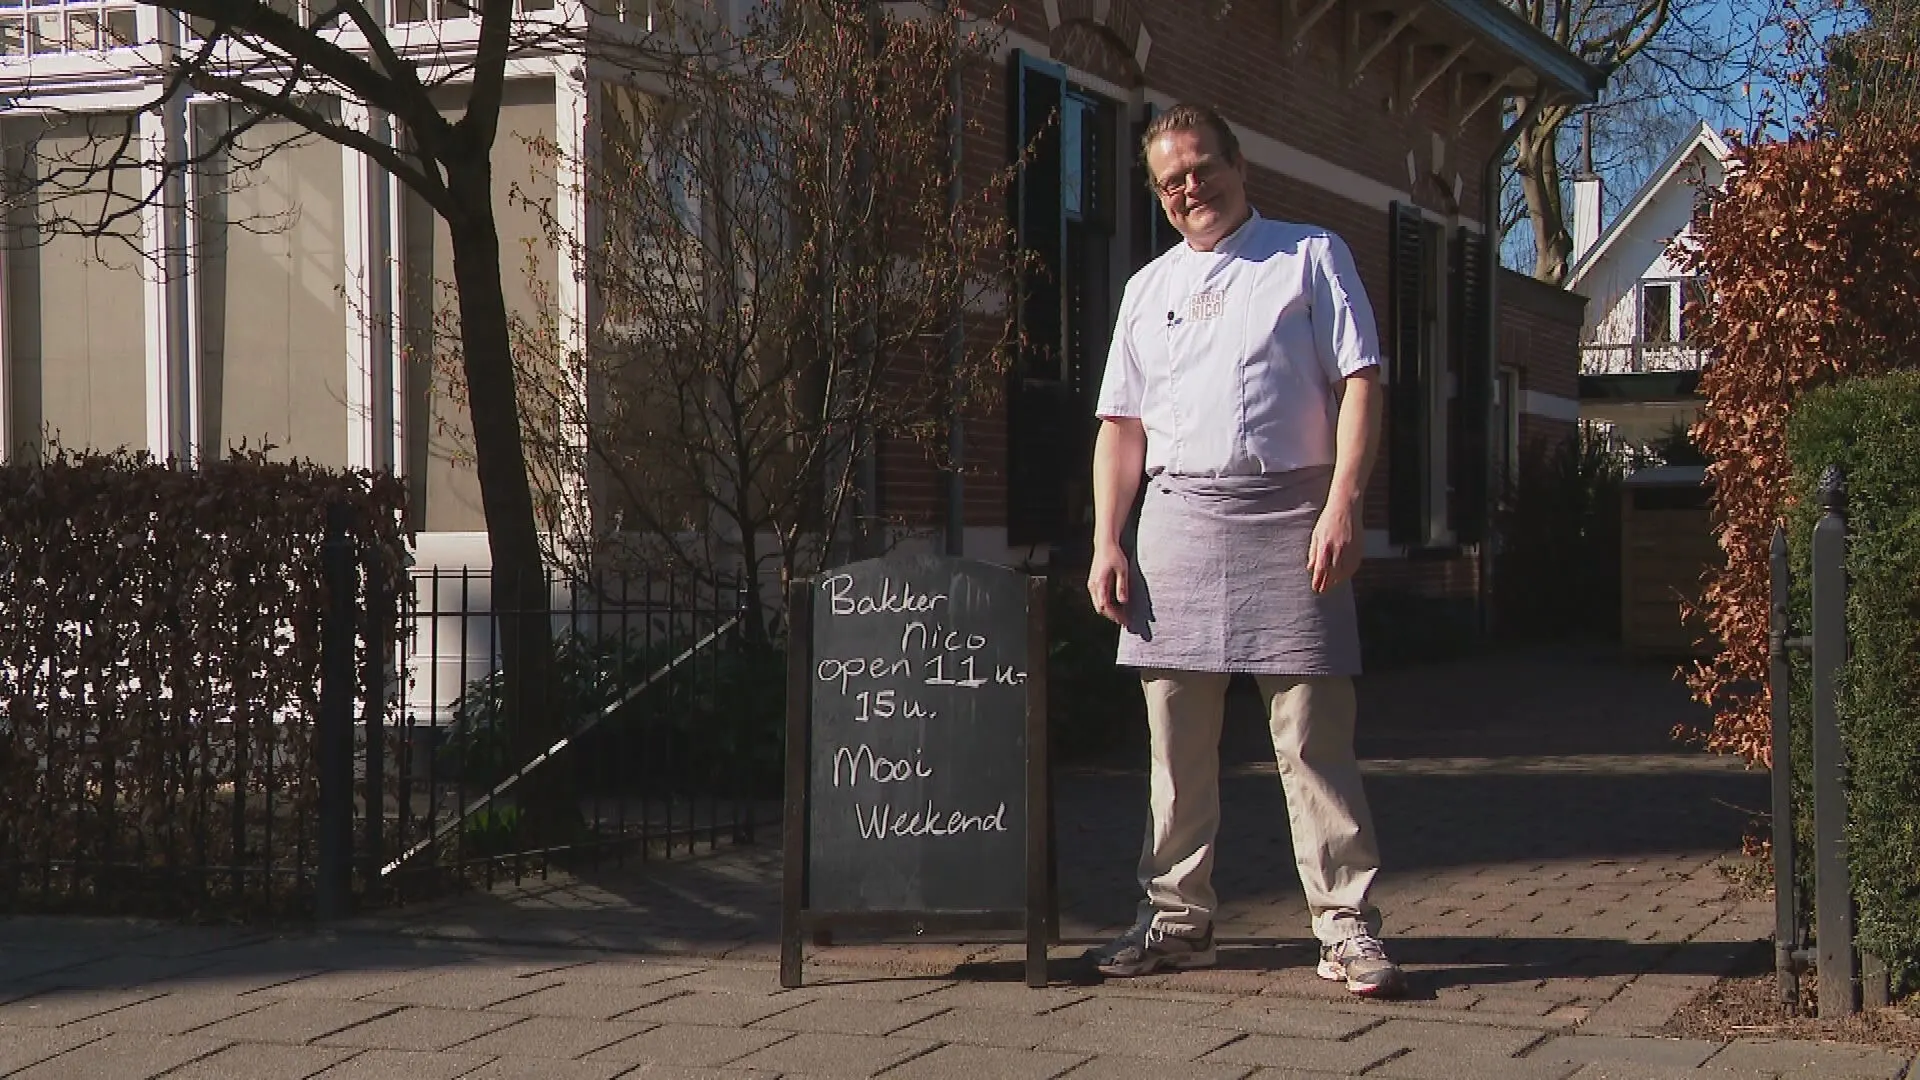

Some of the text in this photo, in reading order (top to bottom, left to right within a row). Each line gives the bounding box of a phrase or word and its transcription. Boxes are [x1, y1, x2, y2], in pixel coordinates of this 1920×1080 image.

[1192, 302, 1221, 319] NICO
[822, 573, 948, 615] Bakker
[817, 657, 911, 695] open
[833, 743, 932, 787] Mooi
[856, 799, 1007, 840] Weekend
